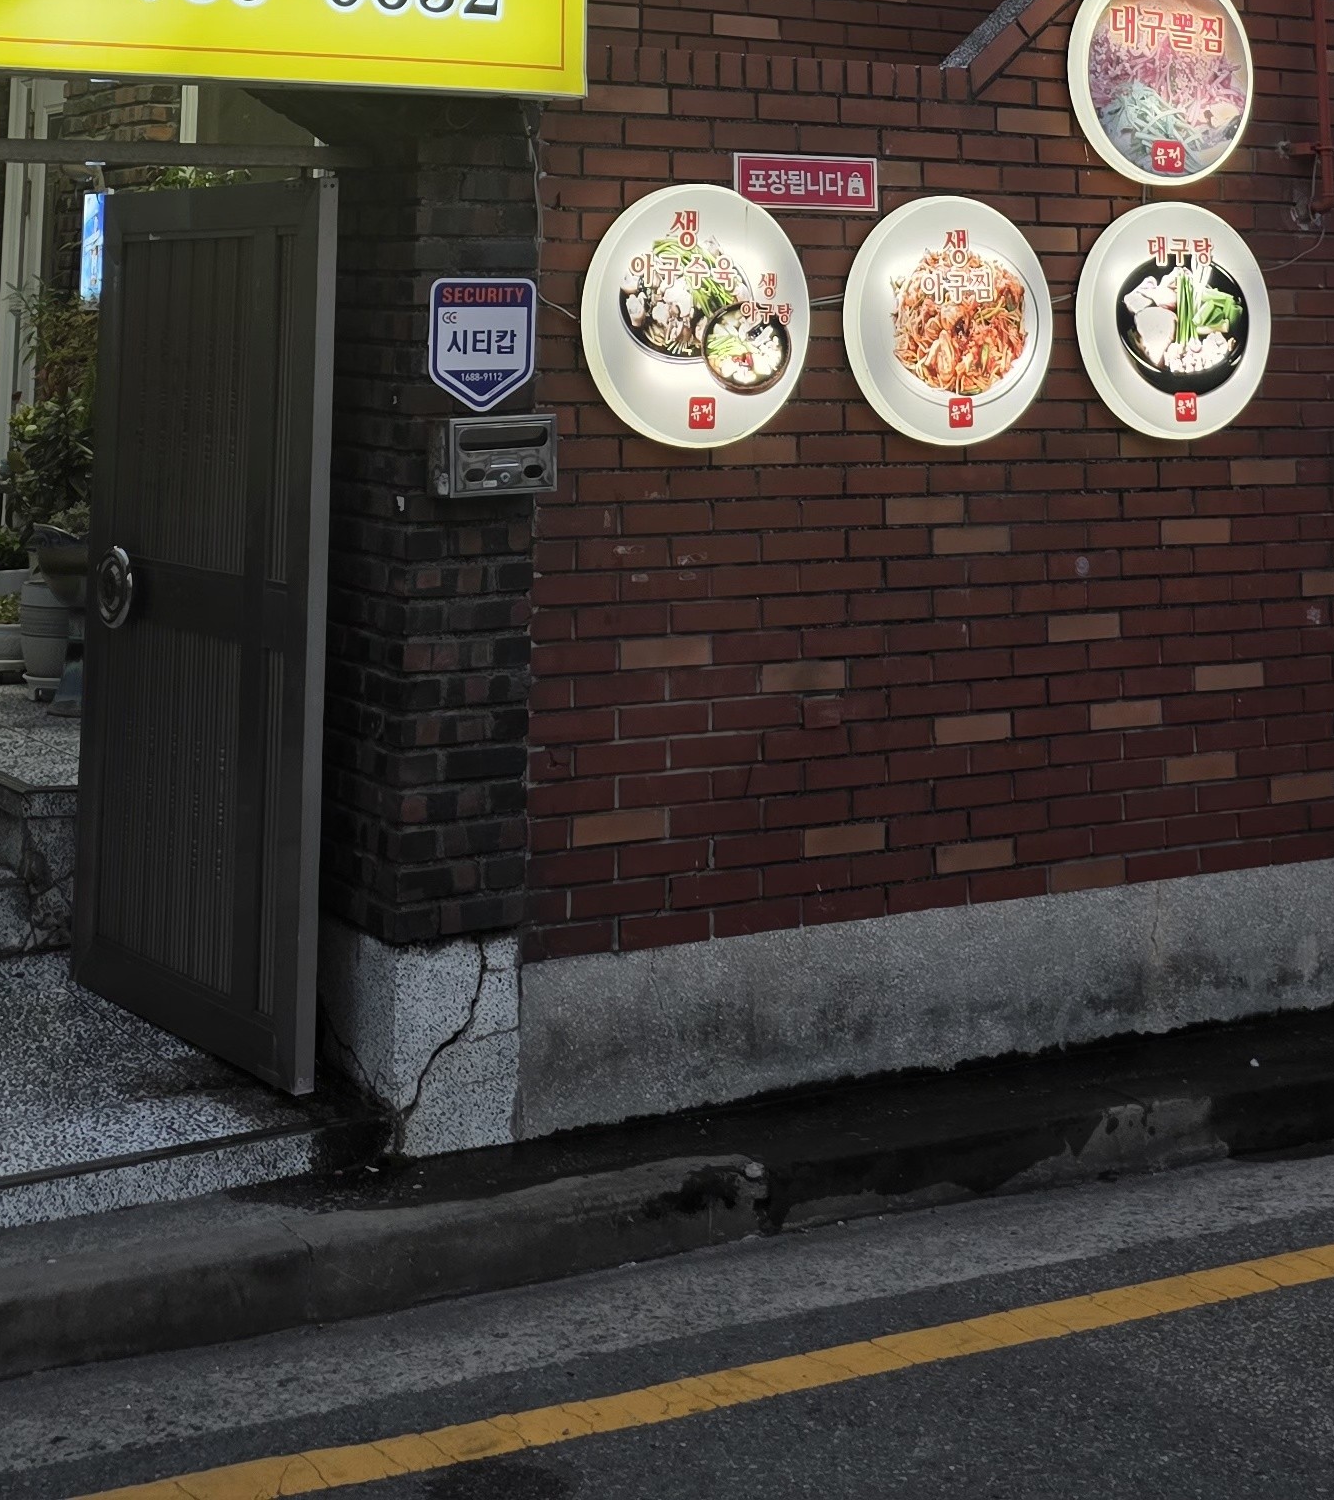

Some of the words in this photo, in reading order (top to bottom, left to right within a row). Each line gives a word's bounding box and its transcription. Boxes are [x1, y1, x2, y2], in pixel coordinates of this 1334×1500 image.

[1111, 5, 1224, 53] 대구뽈찜
[1154, 147, 1183, 168] 유정
[747, 169, 844, 197] 포장됩니다
[670, 210, 698, 248] 생
[943, 229, 967, 266] 생
[1147, 236, 1212, 264] 대구탕
[630, 253, 737, 290] 아구수육
[759, 273, 777, 296] 생
[442, 287, 524, 303] SECURITY
[923, 270, 992, 303] 아구찜
[740, 303, 793, 325] 아구탕
[447, 329, 517, 355] 시티캅
[690, 403, 714, 421] 유정
[950, 401, 972, 421] 유정
[1176, 399, 1196, 415] 유정
